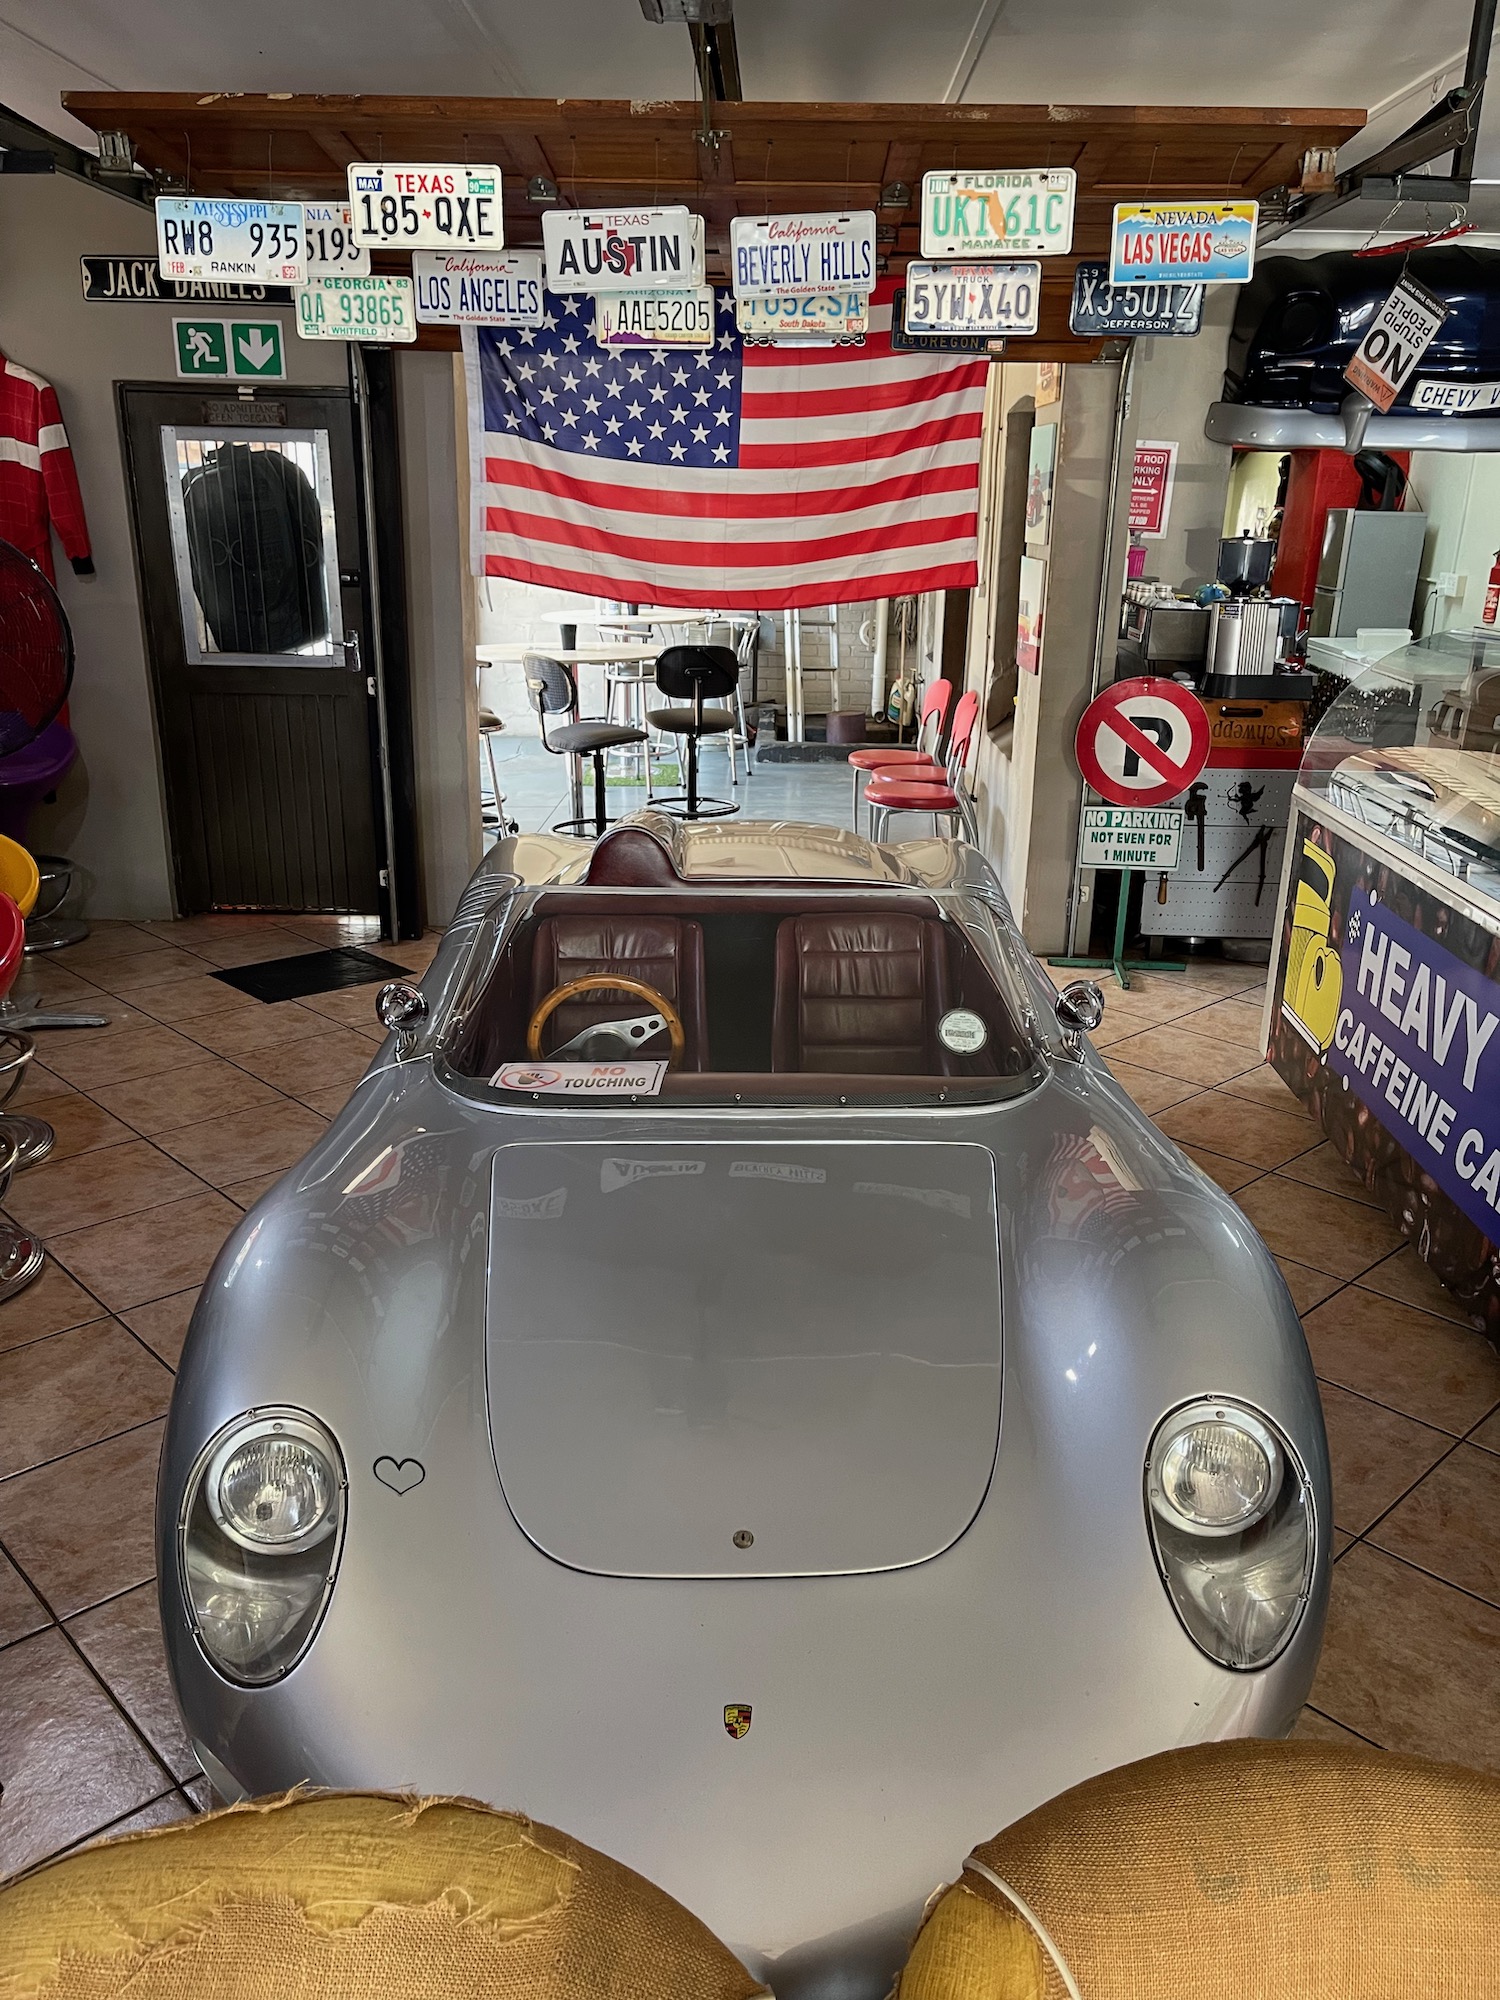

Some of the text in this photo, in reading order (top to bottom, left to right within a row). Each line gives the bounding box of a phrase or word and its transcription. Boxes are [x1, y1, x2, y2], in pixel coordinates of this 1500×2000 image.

[357, 178, 380, 190] MAY
[395, 174, 455, 194] TEXAS
[930, 180, 949, 193] JUN
[964, 176, 1033, 188] FLORIDA
[193, 202, 268, 228] MISSISSIPPI
[306, 209, 333, 221] NIA
[361, 194, 494, 237] 185 QXE
[606, 213, 650, 227] TEXAS
[1154, 211, 1218, 226] NEVADA
[768, 220, 846, 242] California
[164, 219, 299, 260] RW8 935
[961, 238, 1031, 249] MANATEE
[559, 235, 681, 275] AUSTIN
[1123, 231, 1213, 265] LAS VEGAS
[171, 261, 185, 274] FEB
[211, 261, 256, 274] RANKIN
[445, 256, 514, 277] California
[738, 242, 811, 286] BEVERLY
[821, 240, 871, 281] HILLS
[285, 267, 297, 279] 99
[951, 266, 994, 276] TEXAS
[1082, 268, 1099, 278] 19
[103, 261, 161, 298] JACK
[324, 277, 387, 290] GEORGIA
[957, 276, 990, 284] TRUCK
[418, 275, 539, 314] LOS ANGELES
[914, 283, 1032, 321] 5YW X40
[340, 294, 403, 326] 93865
[618, 300, 710, 331] AAE5205
[1389, 295, 1434, 337] PEOPLE
[779, 319, 826, 328] South Dakota
[1102, 318, 1170, 330] JEFFERSON
[1383, 311, 1424, 349] STUPID
[332, 327, 377, 336] WHITFIELD
[896, 333, 914, 345] FEB
[919, 336, 979, 350] OREGON
[1363, 328, 1414, 385] NO
[1352, 365, 1381, 394] WARNING
[1421, 386, 1500, 408] CHEVY V
[208, 413, 233, 423] GEEN
[1143, 455, 1165, 465] ROD
[1134, 465, 1161, 475] RKING
[1132, 476, 1155, 486] NLY
[1211, 719, 1287, 747] Schwepp
[1086, 810, 1180, 830] NO PARKING
[1091, 831, 1172, 846] NOT EVEN FOR
[1104, 849, 1156, 863] 1 MINUTE
[1356, 921, 1500, 1093] HEAVY
[591, 1067, 627, 1077] NO
[564, 1077, 647, 1089] TOUCHING
[1334, 1007, 1500, 1215] CAFFEINE CA
